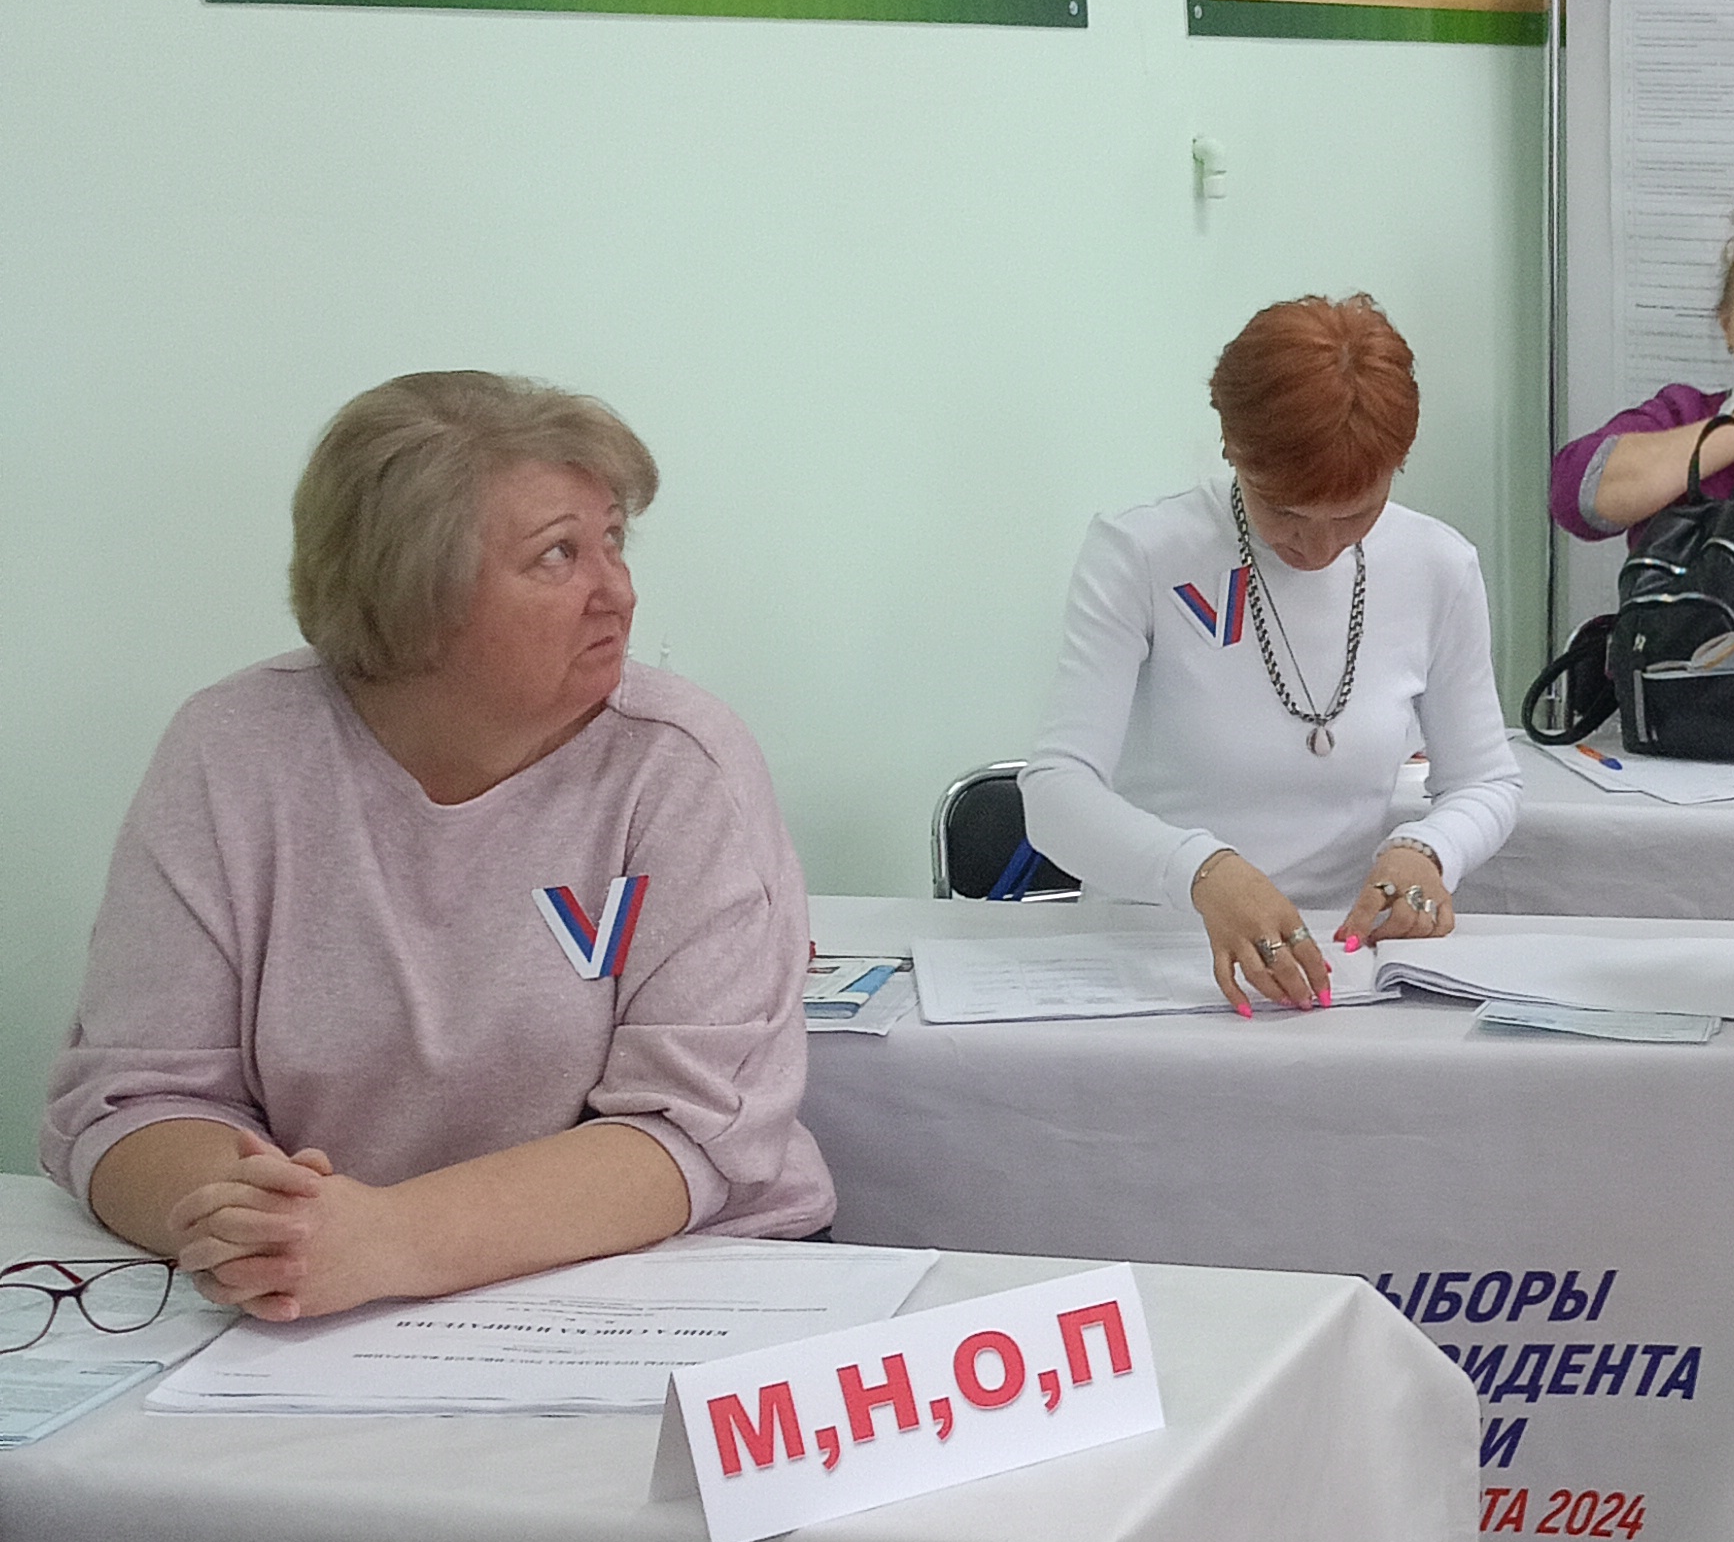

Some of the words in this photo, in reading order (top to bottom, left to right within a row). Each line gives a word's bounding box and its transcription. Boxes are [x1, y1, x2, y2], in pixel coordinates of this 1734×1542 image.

[1374, 1269, 1619, 1324] ЫБОРЫ
[706, 1300, 1134, 1478] М,Н,О,П
[1535, 1488, 1648, 1541] 2024
